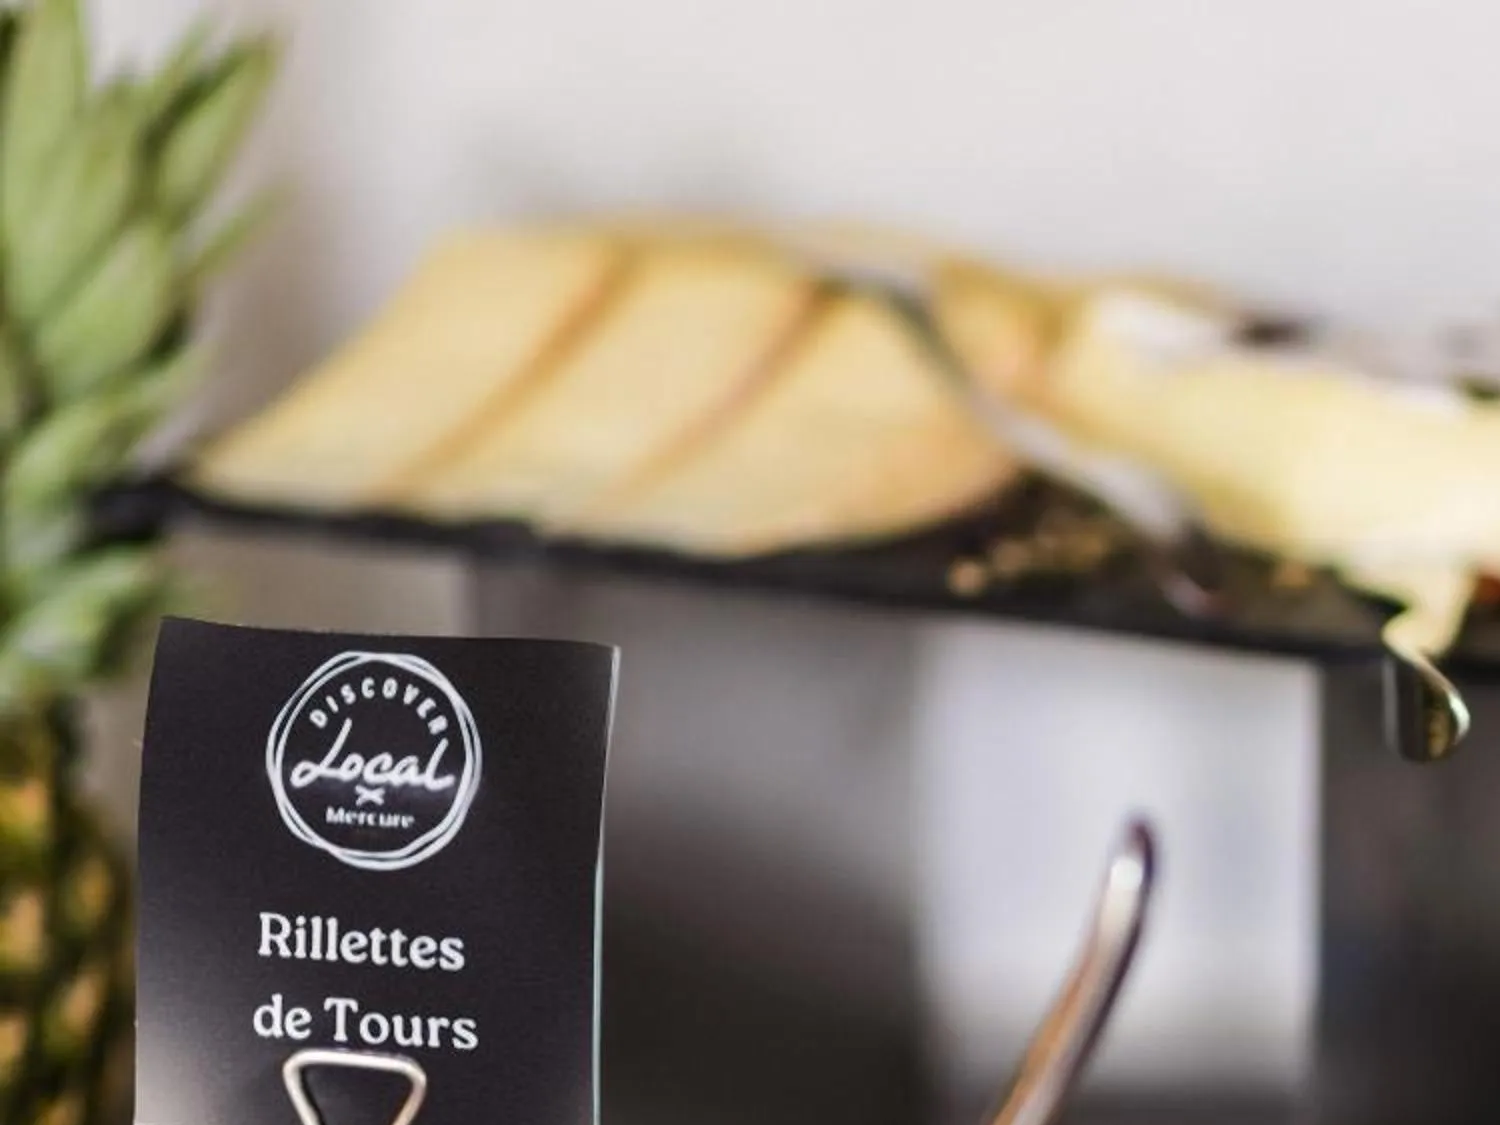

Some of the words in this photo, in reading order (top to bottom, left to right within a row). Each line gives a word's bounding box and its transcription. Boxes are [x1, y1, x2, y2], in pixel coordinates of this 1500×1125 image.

[308, 676, 450, 737] DISCOVER
[289, 717, 456, 792] Local
[324, 804, 416, 831] Mercure
[257, 911, 466, 972] Rillettes
[252, 992, 313, 1041] de
[323, 996, 480, 1051] Tours
